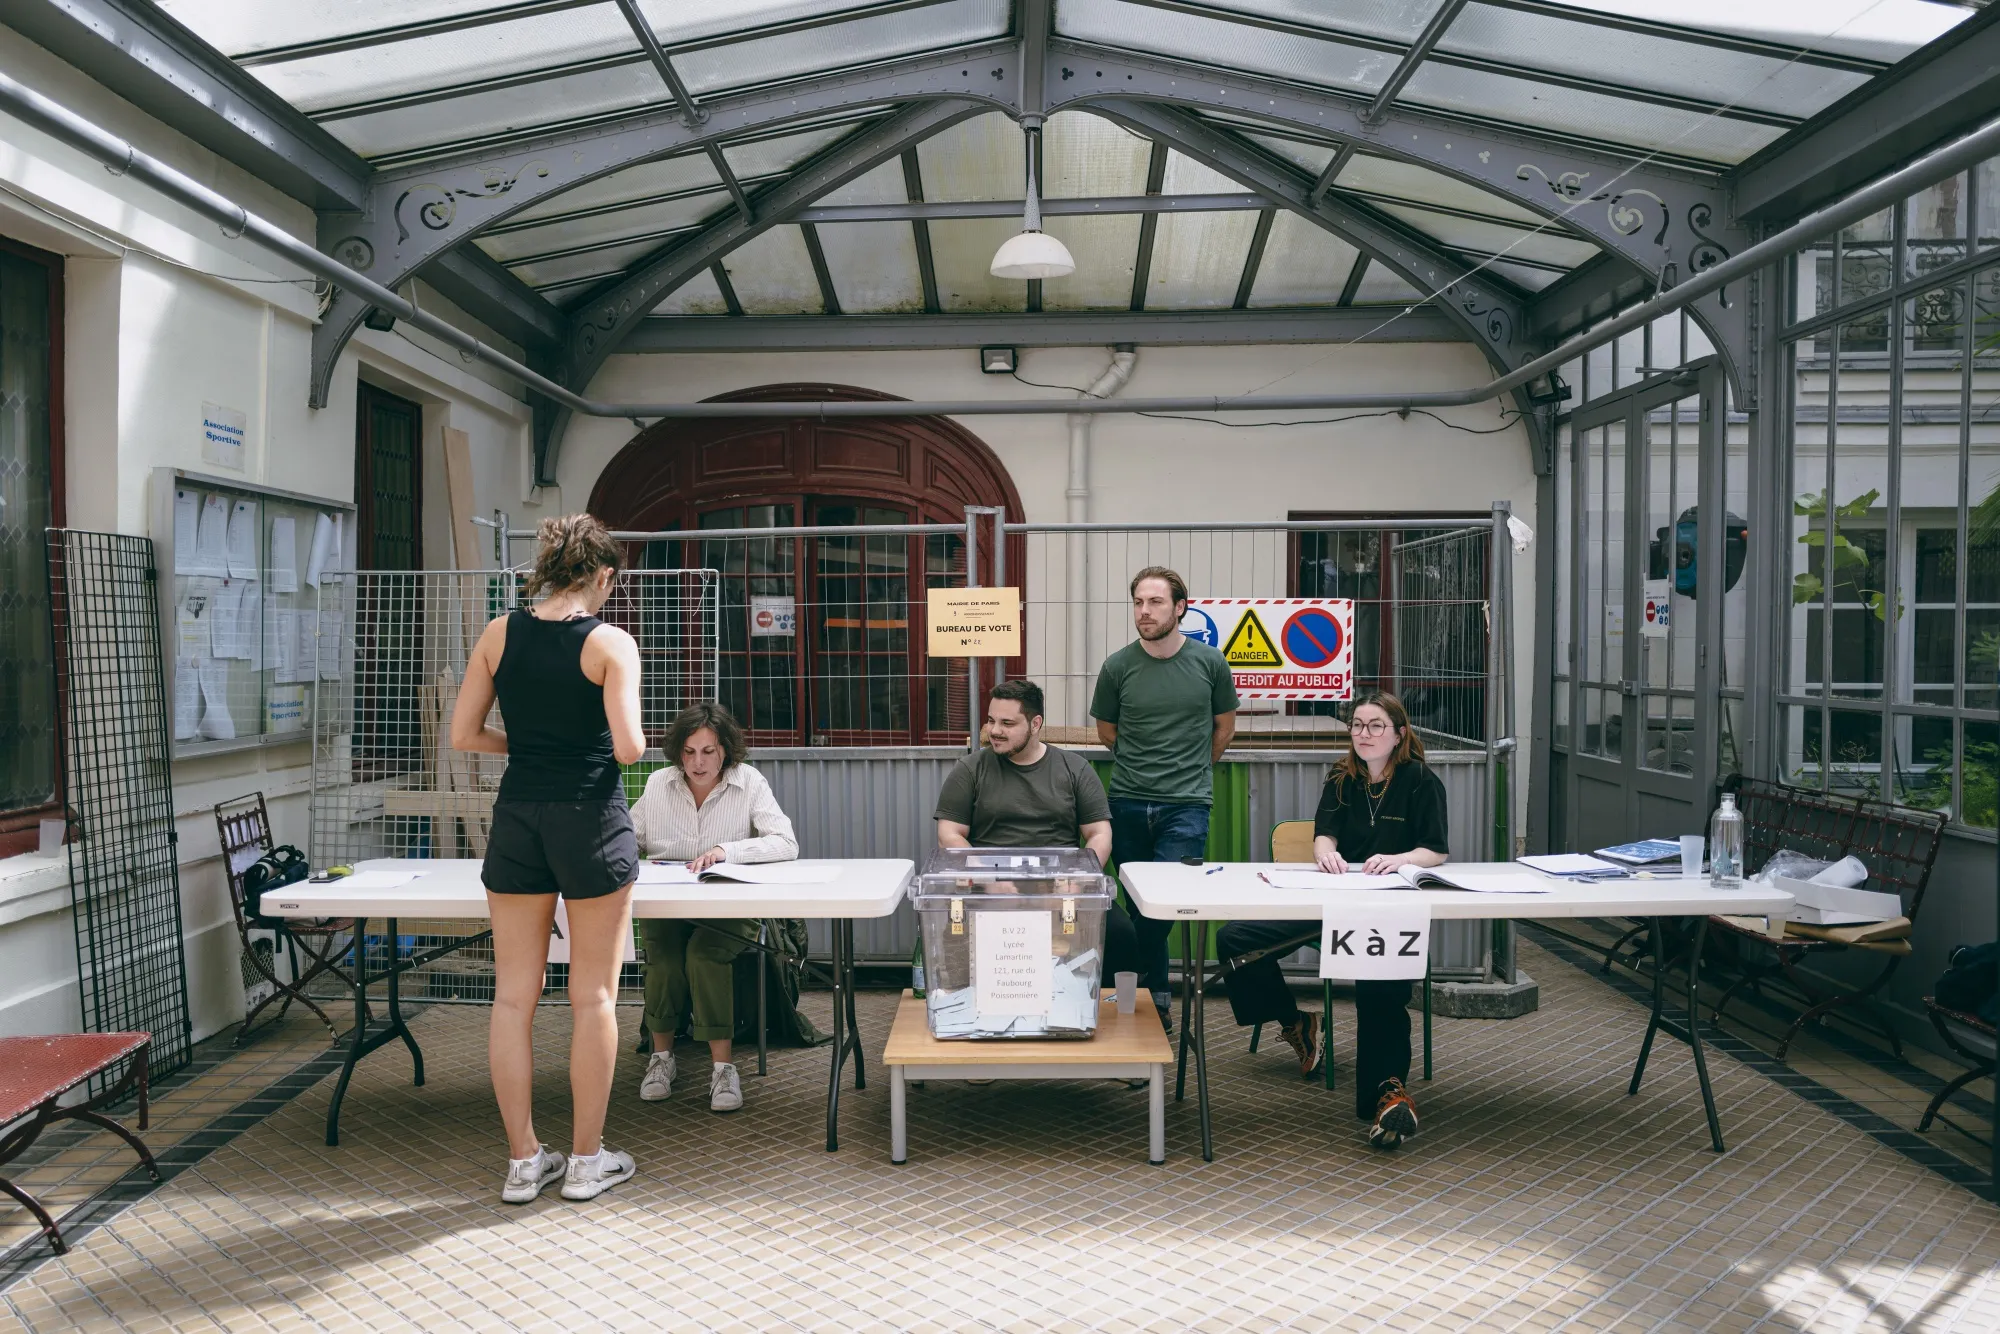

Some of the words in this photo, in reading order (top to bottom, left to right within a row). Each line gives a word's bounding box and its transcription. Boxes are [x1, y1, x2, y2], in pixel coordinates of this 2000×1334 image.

[203, 419, 244, 436] Association
[206, 431, 241, 446] Sportive
[988, 624, 1012, 632] VOTE
[961, 638, 972, 646] N°
[1231, 651, 1269, 660] DANGER
[1232, 674, 1274, 686] TERDIT
[1277, 674, 1294, 686] AU
[1297, 675, 1341, 687] PUBLIC
[271, 711, 302, 720] Sportive
[1003, 941, 1025, 949] Lycée
[1331, 929, 1355, 956] K
[1366, 929, 1386, 956] à
[1398, 931, 1421, 956] Z
[995, 953, 1033, 961] Lamartine
[1025, 966, 1036, 974] du
[996, 979, 1032, 988] Faubourg
[990, 991, 1039, 999] Poissonnière
